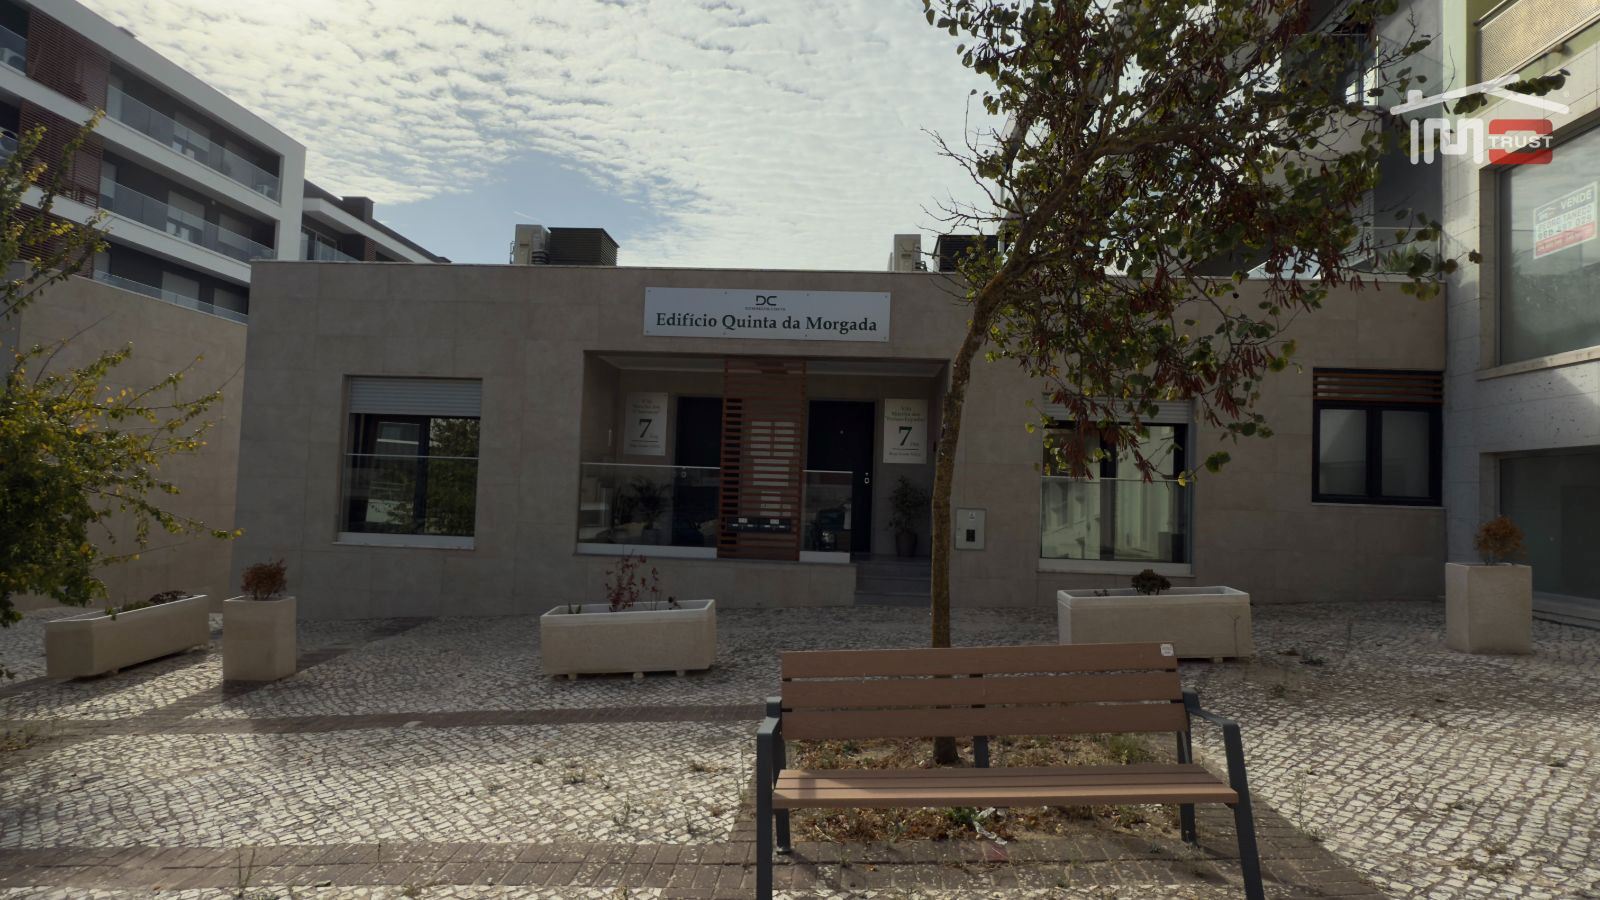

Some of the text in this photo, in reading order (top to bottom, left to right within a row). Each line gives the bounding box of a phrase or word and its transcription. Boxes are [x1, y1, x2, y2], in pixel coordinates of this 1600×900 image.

[1560, 189, 1593, 210] VENDE
[755, 295, 778, 306] DC
[656, 312, 878, 335] Edifício Quinta da Morgada
[639, 418, 653, 439] 7
[898, 425, 913, 446] 7
